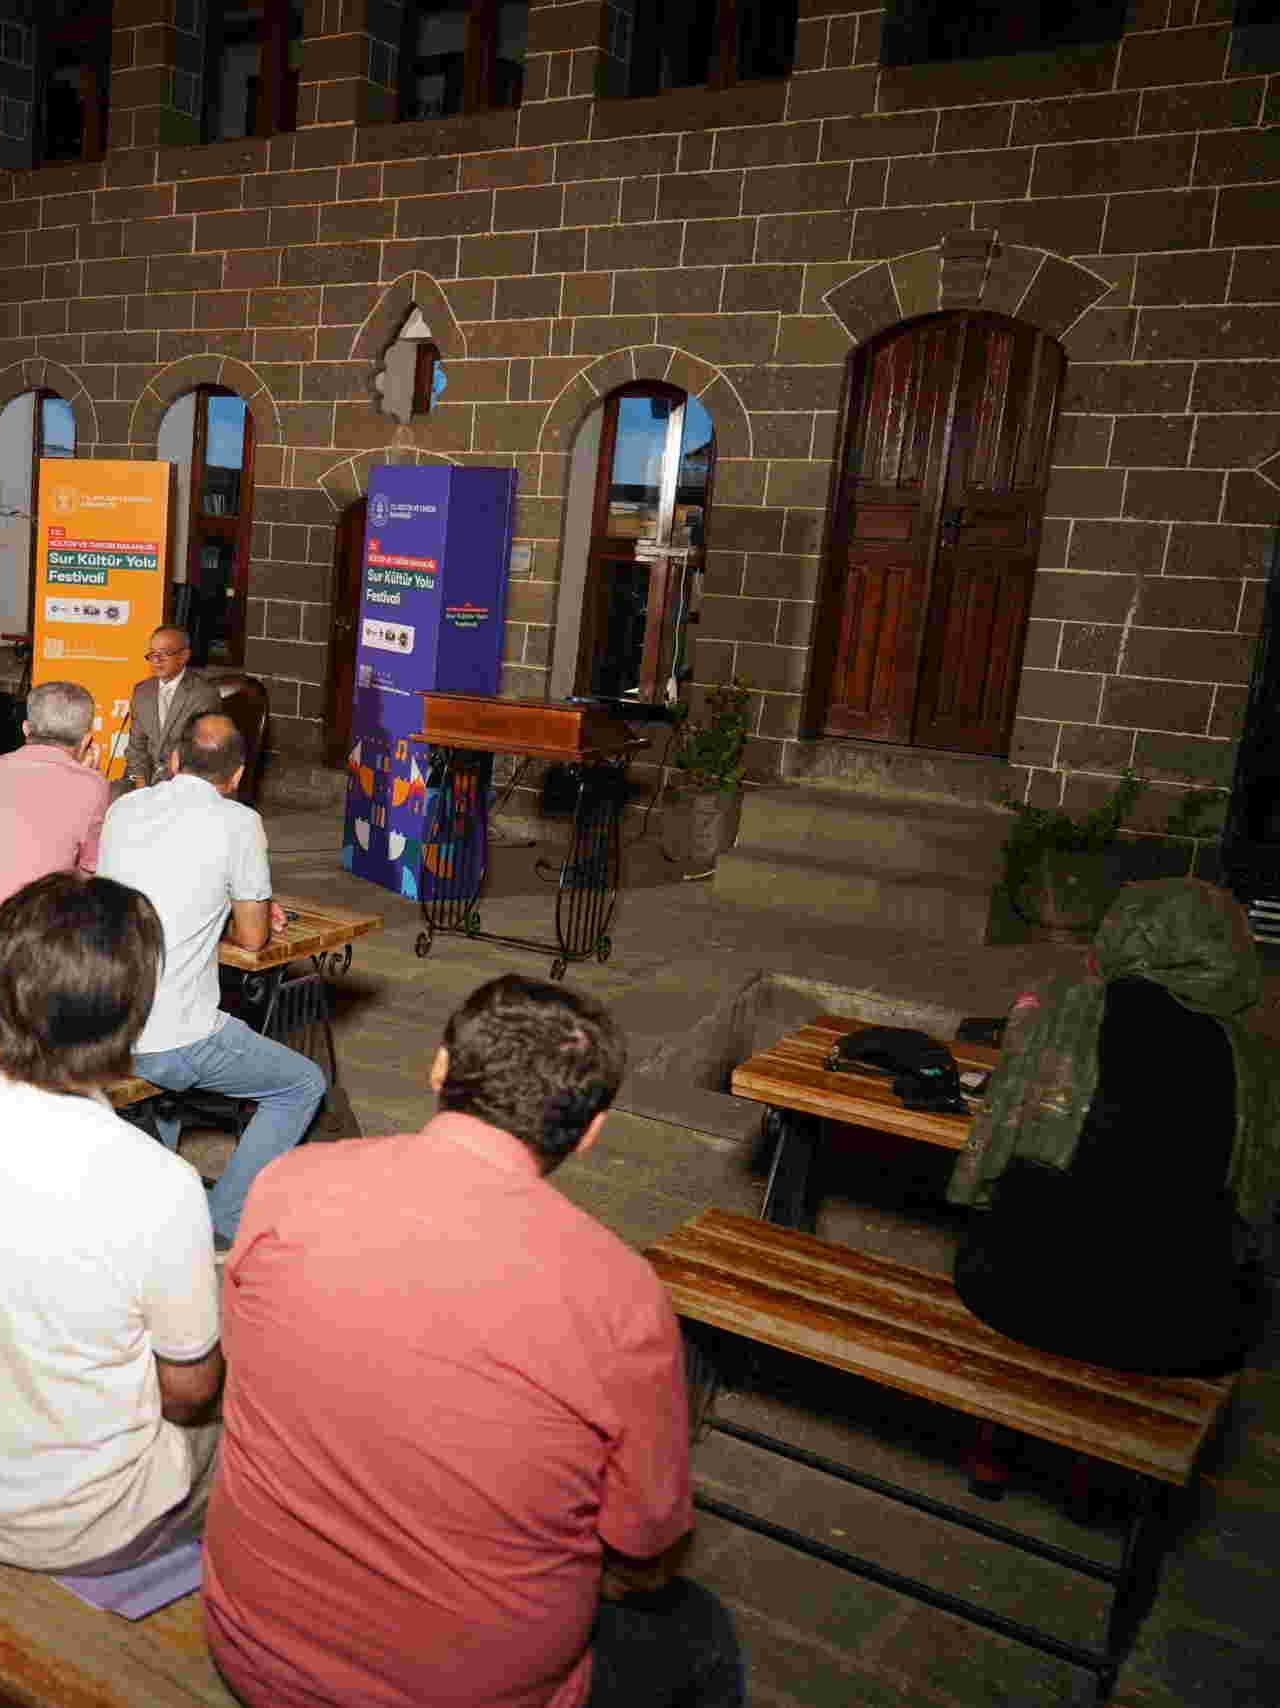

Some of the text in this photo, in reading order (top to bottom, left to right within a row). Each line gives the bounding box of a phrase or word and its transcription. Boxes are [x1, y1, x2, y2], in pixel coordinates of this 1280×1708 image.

[48, 552, 157, 568] Sur Kültür Yolu
[48, 570, 105, 584] Festivali
[367, 568, 383, 582] Sur
[415, 574, 434, 590] Yolu
